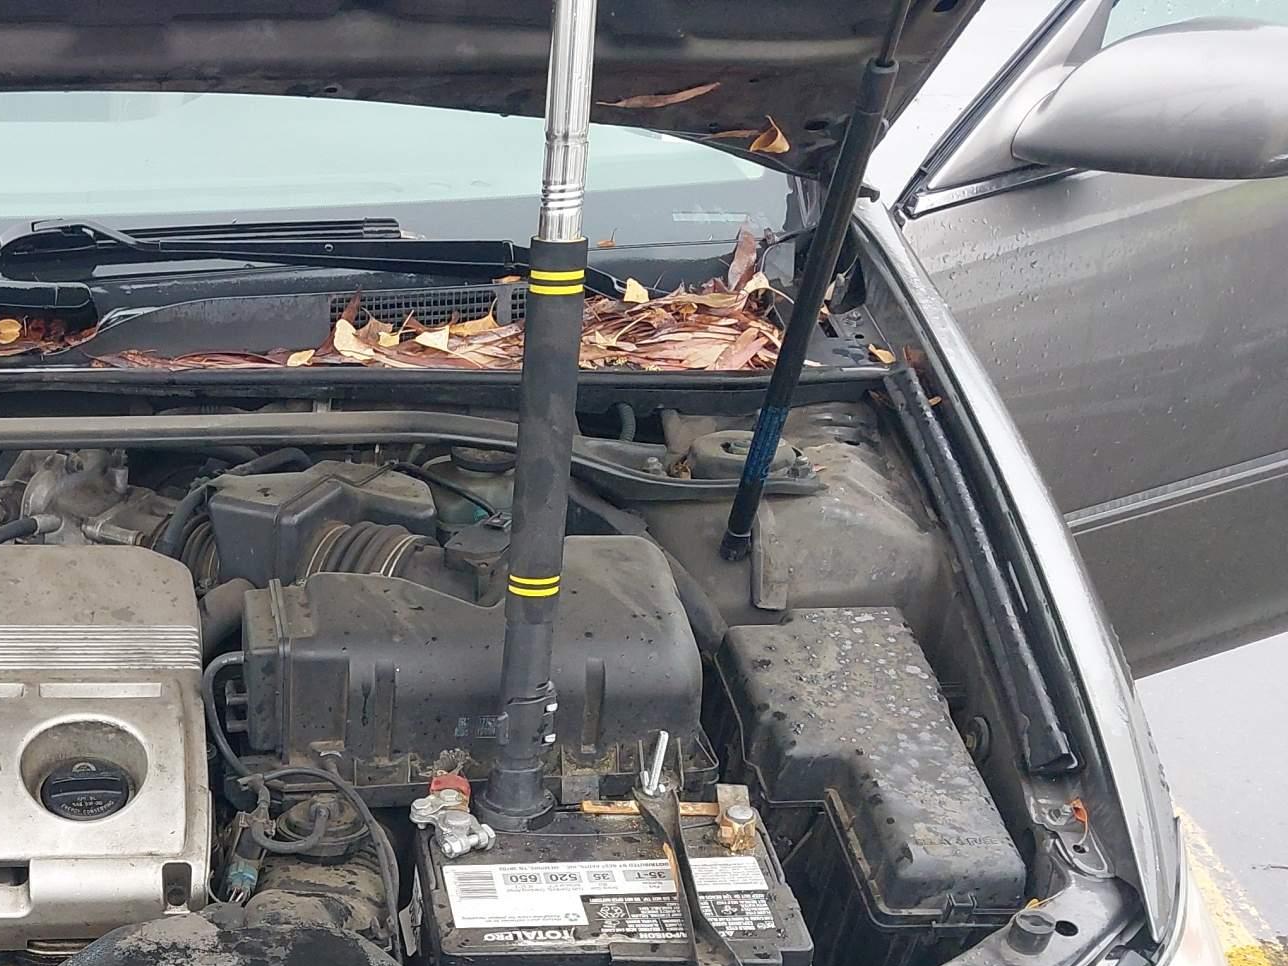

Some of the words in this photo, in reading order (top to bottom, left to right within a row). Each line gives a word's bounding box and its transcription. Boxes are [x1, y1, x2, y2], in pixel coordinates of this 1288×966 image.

[509, 874, 538, 883] 650
[549, 873, 578, 882] 520
[593, 873, 610, 881] 35
[635, 871, 666, 880] 35-T
